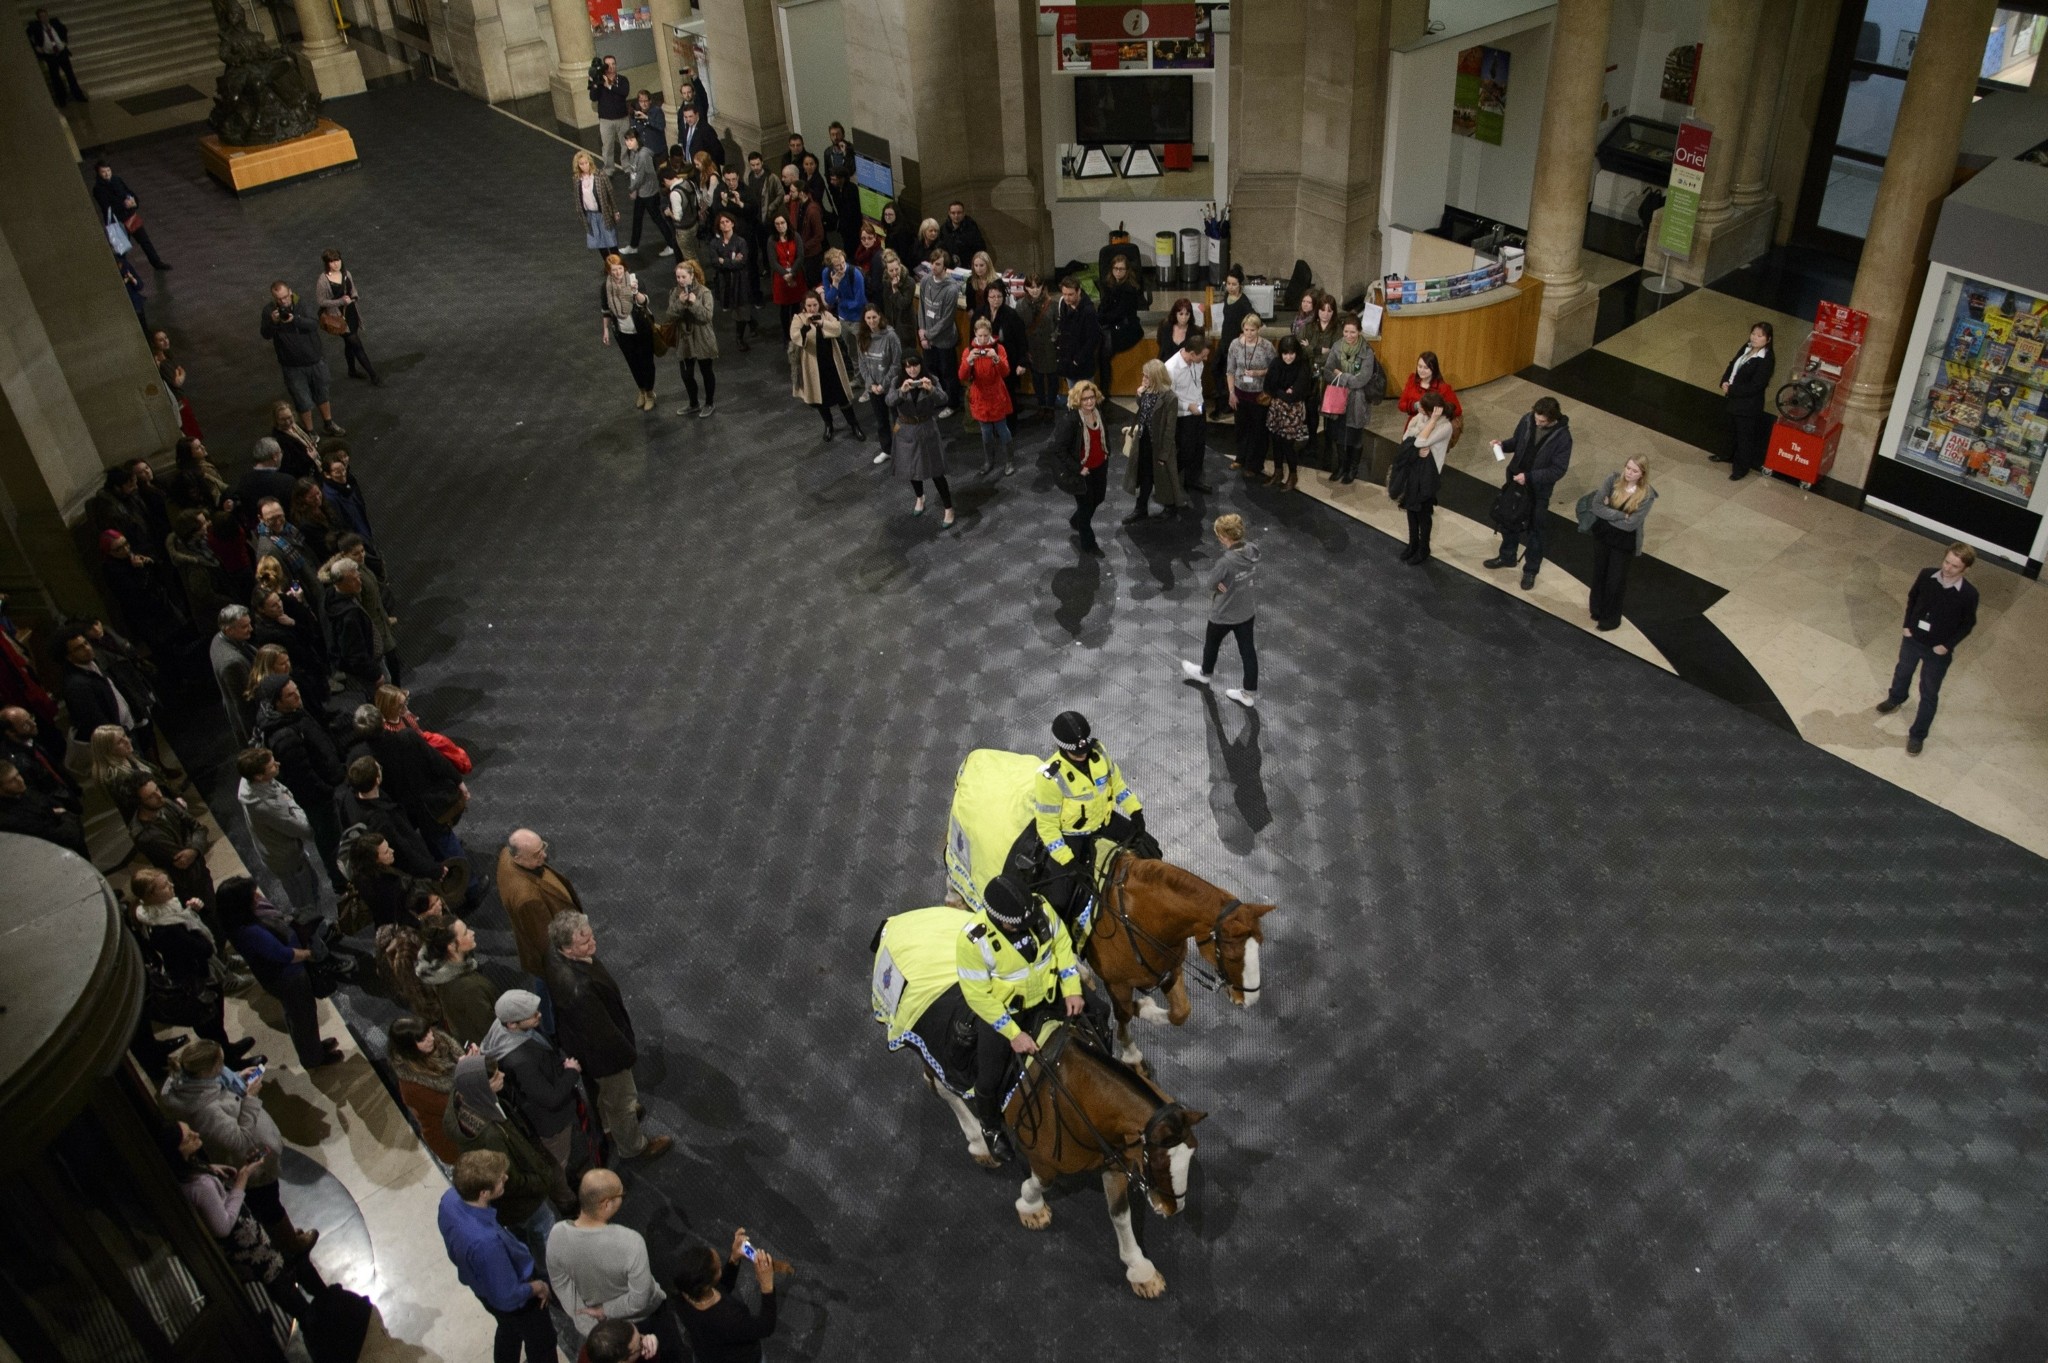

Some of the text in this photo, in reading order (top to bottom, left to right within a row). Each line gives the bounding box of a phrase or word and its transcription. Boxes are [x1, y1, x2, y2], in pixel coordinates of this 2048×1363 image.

[1676, 147, 1707, 167] Oriel
[1791, 442, 1802, 452] The
[1777, 448, 1795, 462] Penny
[1794, 454, 1809, 466] Press
